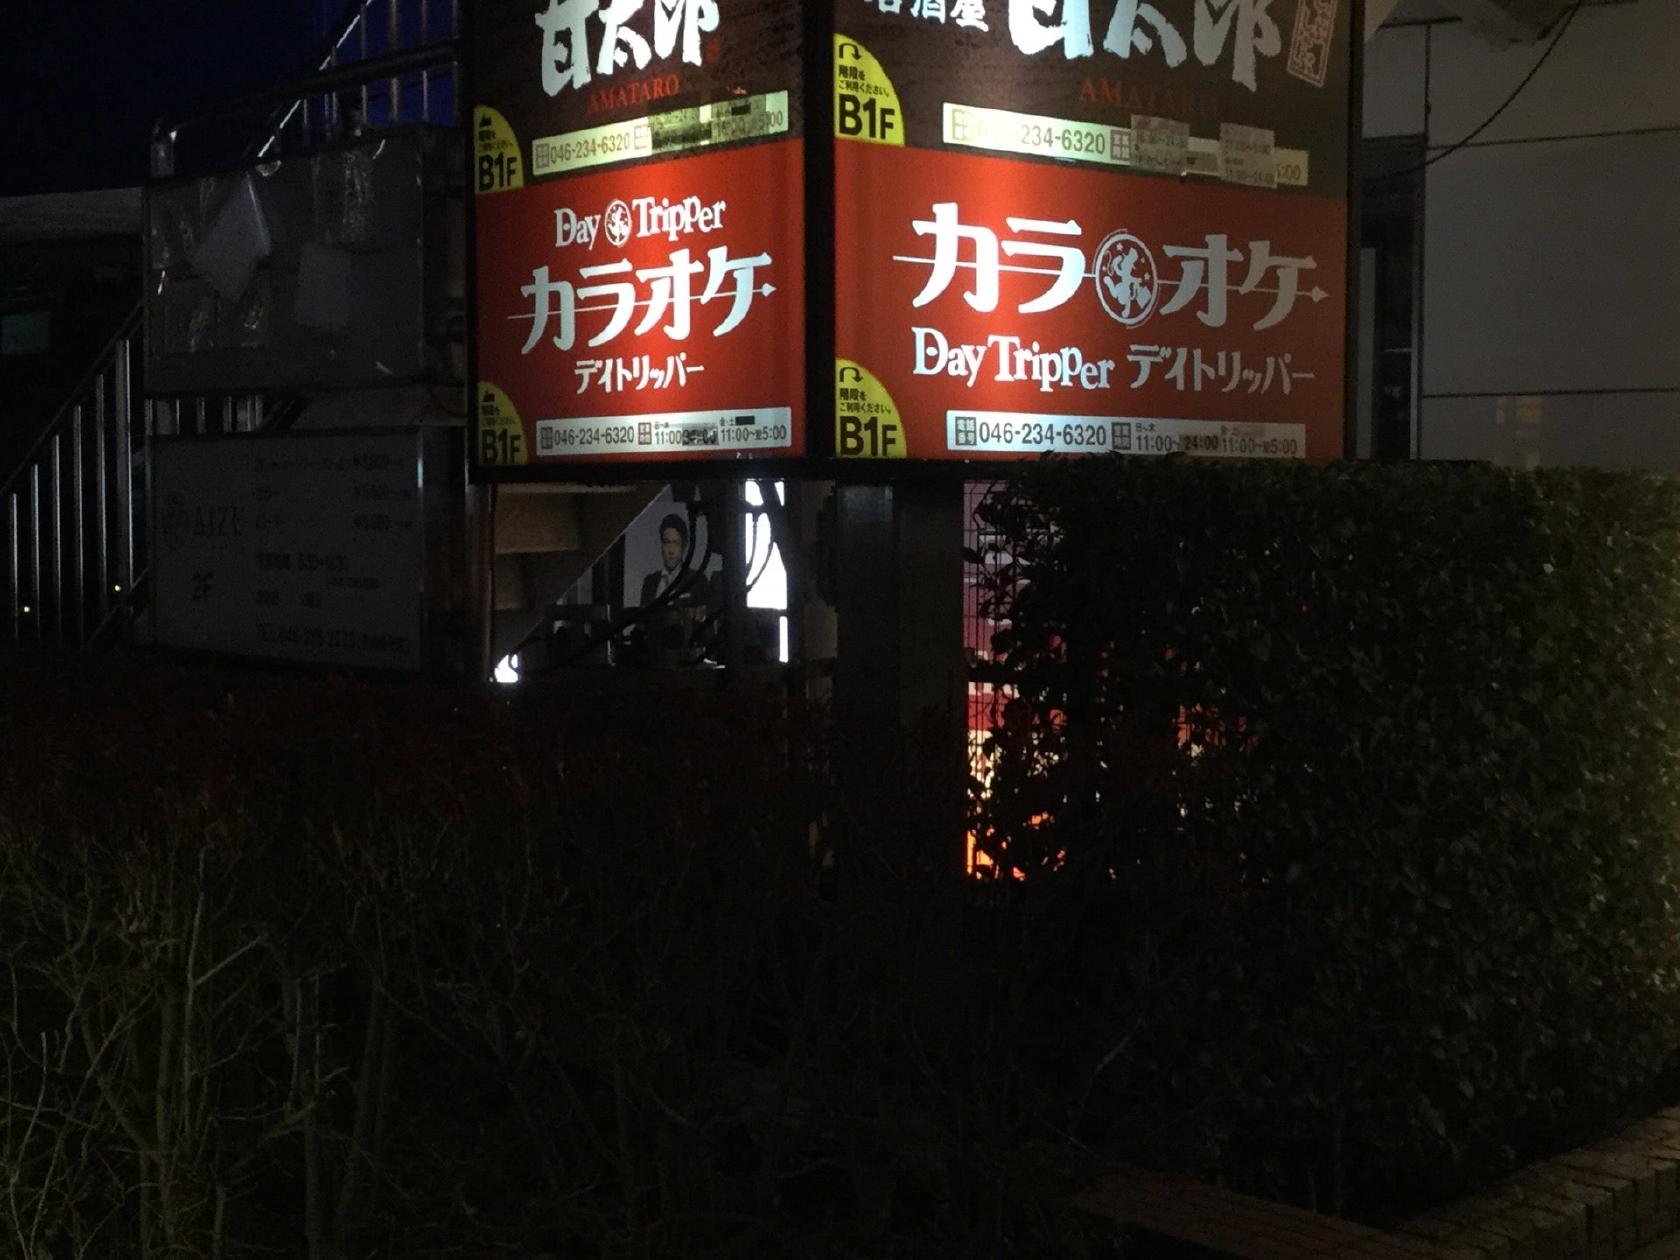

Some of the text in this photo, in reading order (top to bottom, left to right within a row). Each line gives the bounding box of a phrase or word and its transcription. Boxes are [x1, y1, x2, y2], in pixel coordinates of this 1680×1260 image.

[588, 74, 681, 114] AMATARO
[839, 93, 896, 140] B1F
[551, 132, 631, 165] 046-234-6320
[479, 152, 517, 191] B1F
[554, 196, 727, 250] Day Tripper
[521, 245, 773, 354] カラオケ
[481, 428, 521, 464] B1F
[554, 426, 635, 446] 046-234-6320
[840, 415, 897, 457] B1F
[979, 422, 1106, 446] 046-234-6320
